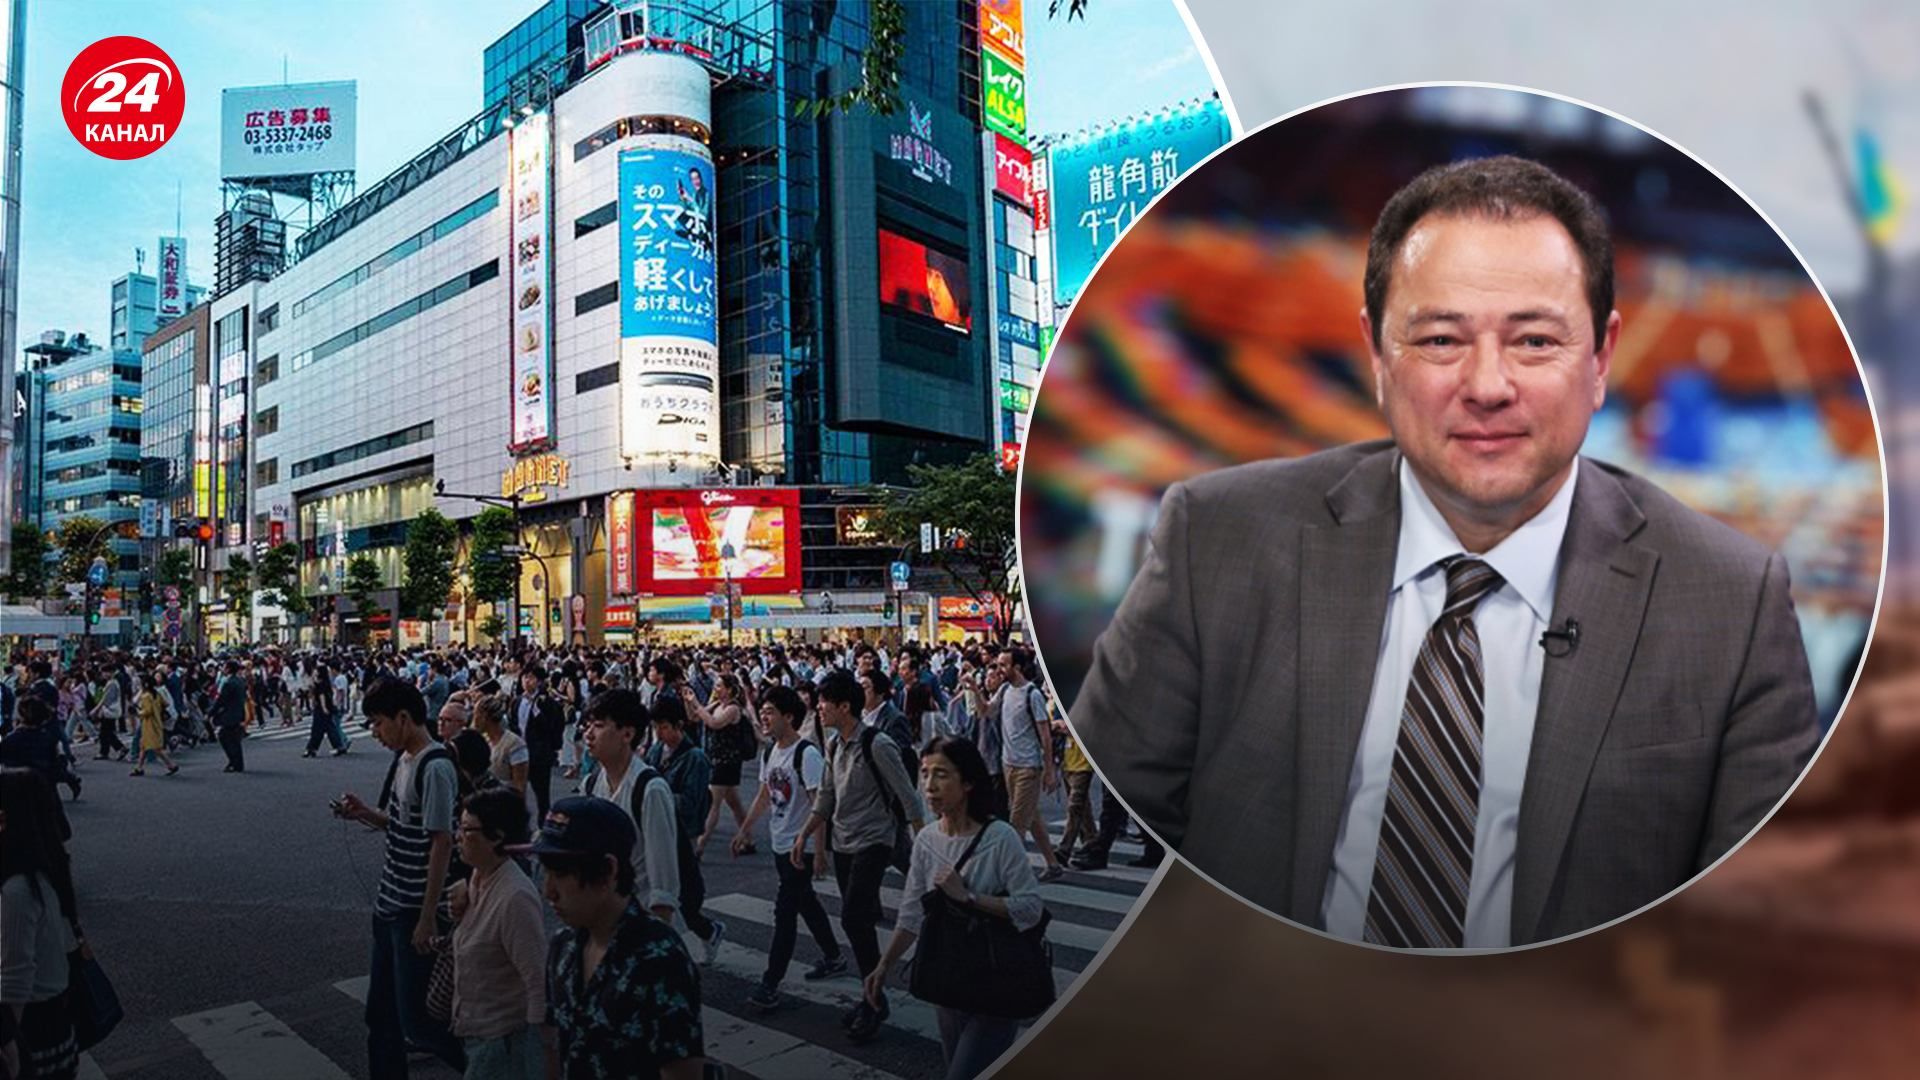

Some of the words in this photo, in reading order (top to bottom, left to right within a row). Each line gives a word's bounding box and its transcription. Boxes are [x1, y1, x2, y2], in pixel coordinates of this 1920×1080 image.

[988, 88, 1025, 130] ALSA
[633, 184, 665, 200] その
[1089, 147, 1179, 205] 龍角散
[1079, 201, 1137, 246] ダイ
[633, 257, 713, 299] 軽くして
